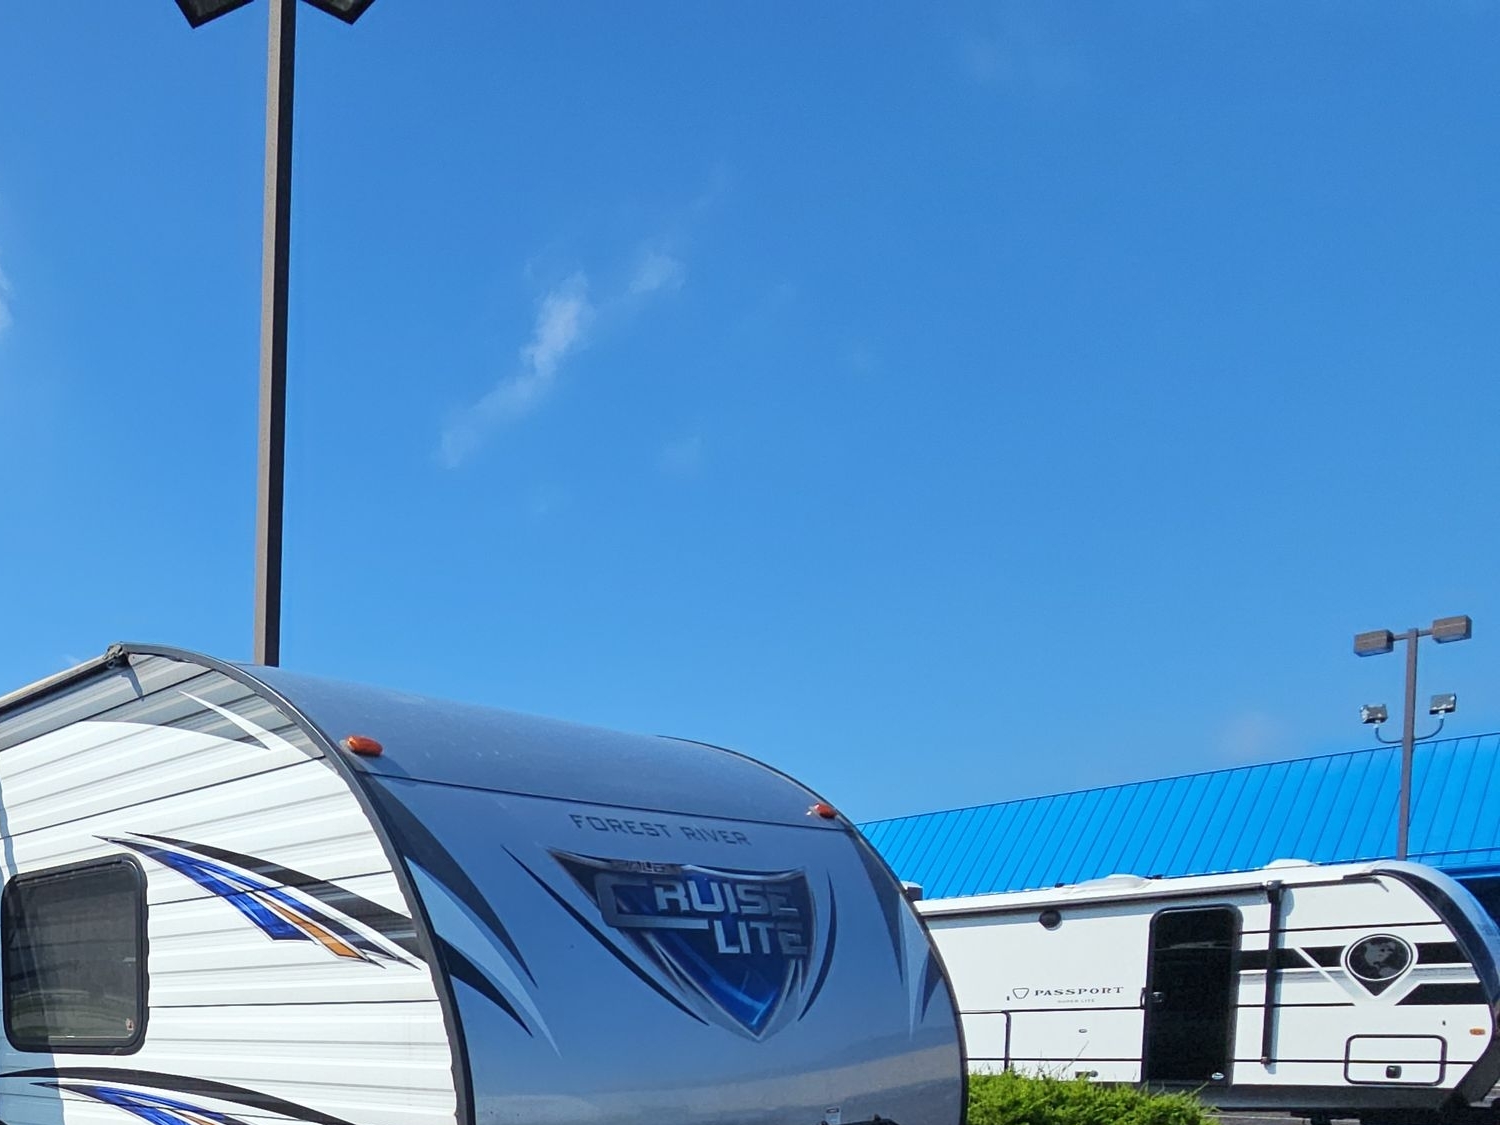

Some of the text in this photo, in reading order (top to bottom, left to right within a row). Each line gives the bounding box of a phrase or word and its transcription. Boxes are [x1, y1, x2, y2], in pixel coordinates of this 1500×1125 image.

[568, 814, 752, 846] FOREST RIVER
[594, 873, 799, 929] CRUISE
[713, 918, 808, 954] LITE
[1034, 986, 1125, 997] PASSPORT
